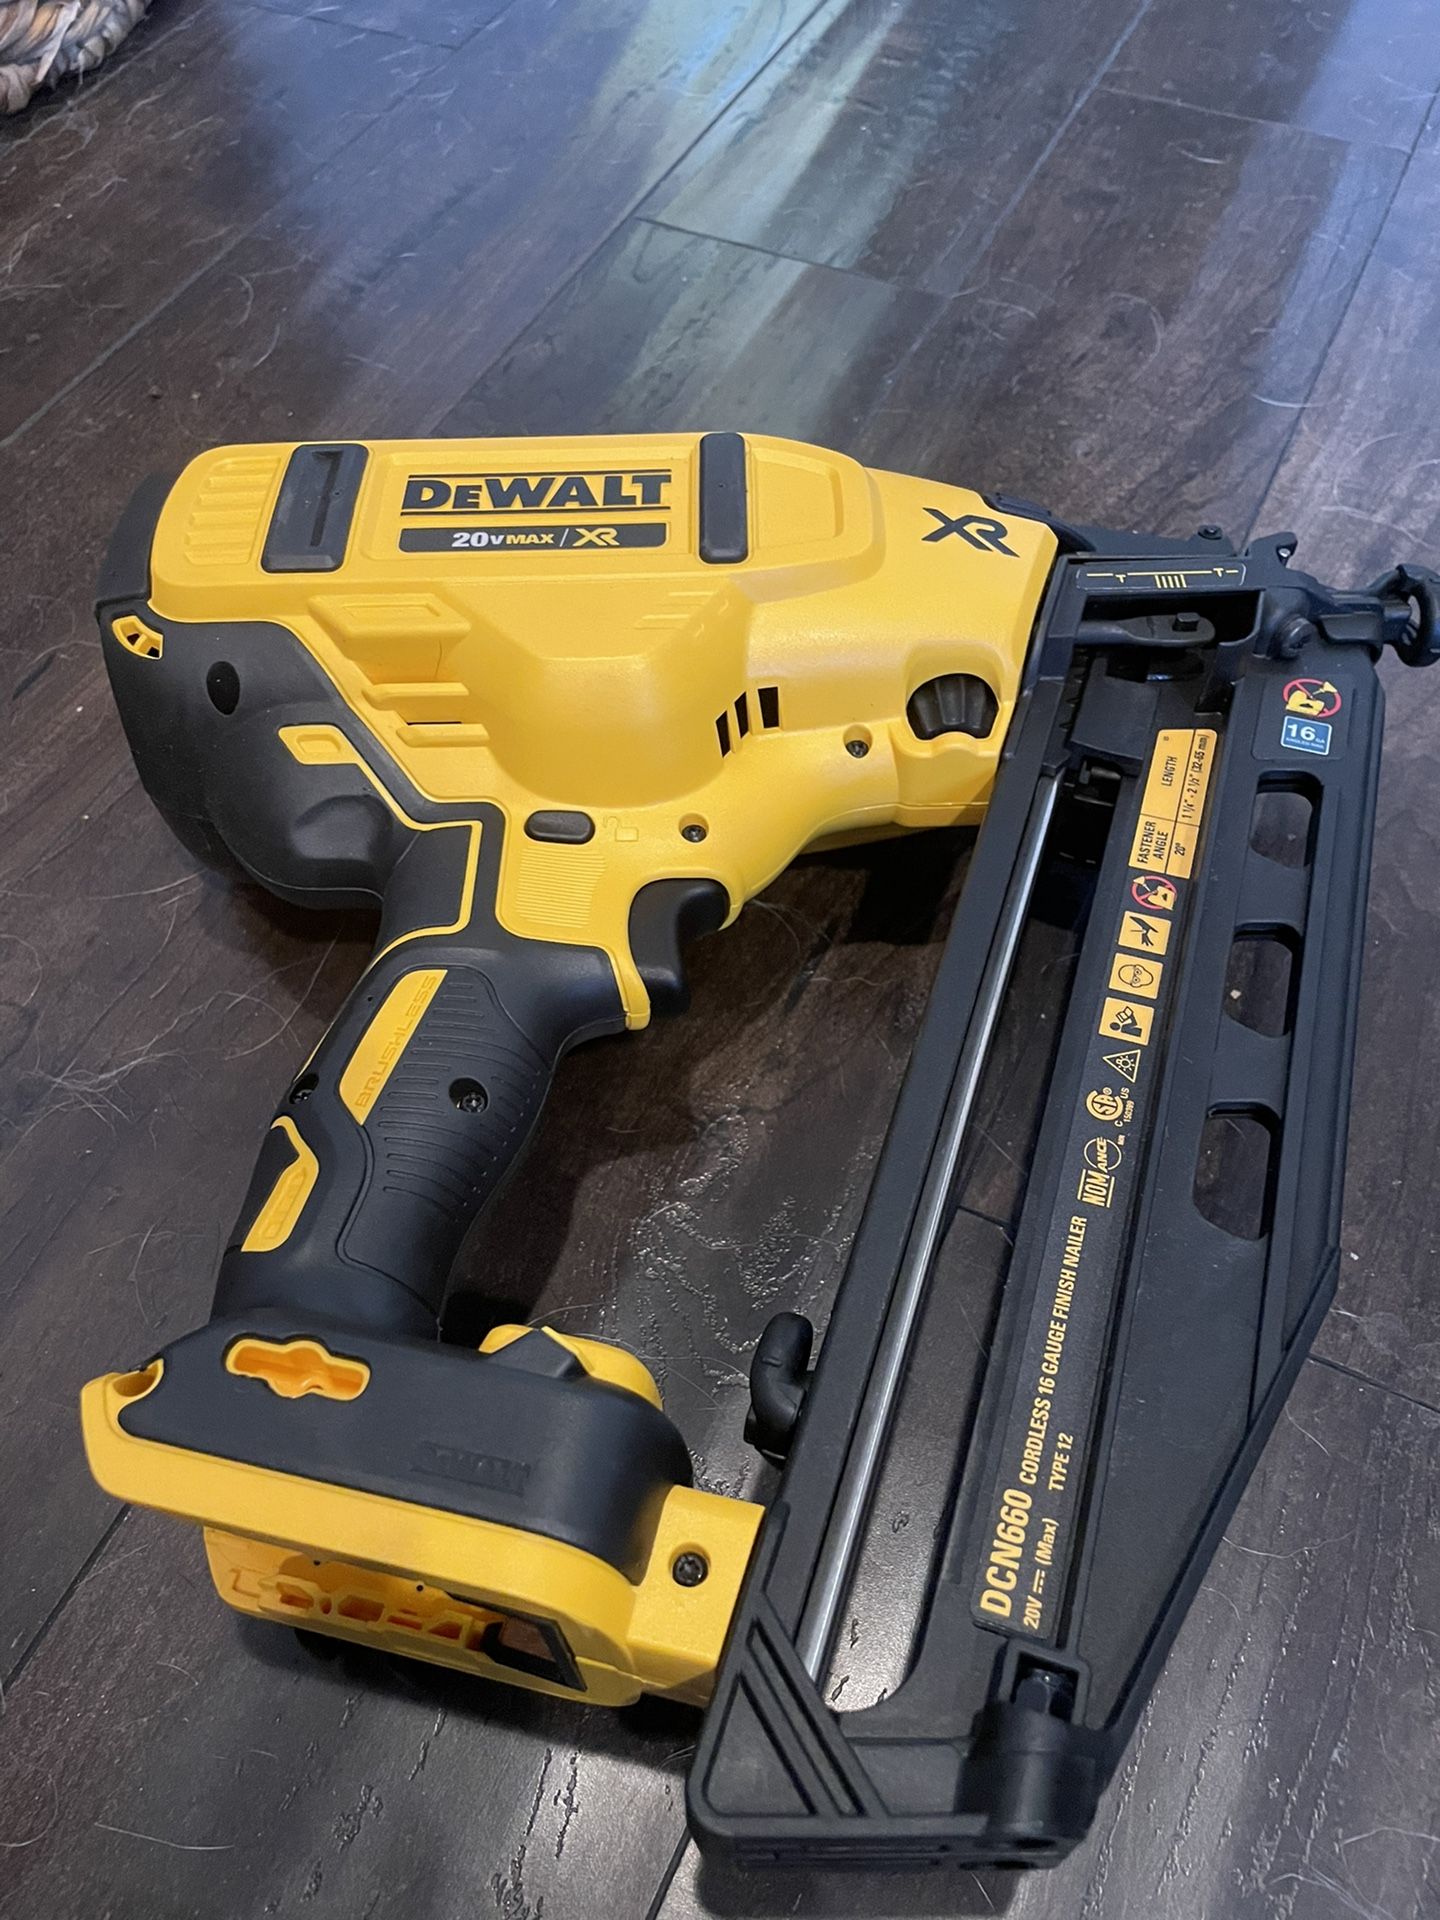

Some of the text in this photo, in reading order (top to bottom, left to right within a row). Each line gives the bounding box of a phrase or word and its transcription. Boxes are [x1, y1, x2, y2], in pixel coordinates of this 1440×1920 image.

[401, 474, 672, 510] DEWALT
[572, 527, 620, 547] XR
[921, 507, 1020, 558] XR
[1287, 723, 1316, 741] 16
[1161, 756, 1178, 787] LENGTH
[1137, 821, 1157, 864] FASTENER
[1152, 831, 1169, 860] ANGLE
[355, 976, 437, 1108] BRUSHLESS
[1120, 1087, 1129, 1099] US
[1082, 1136, 1110, 1207] NOM ANCE
[980, 1215, 1088, 1617] DCN660 CORDLESS 16 GAUGE FINISH NAILER
[1048, 1432, 1074, 1490] TYPE 12
[1023, 1517, 1060, 1629] 20V (Max)
